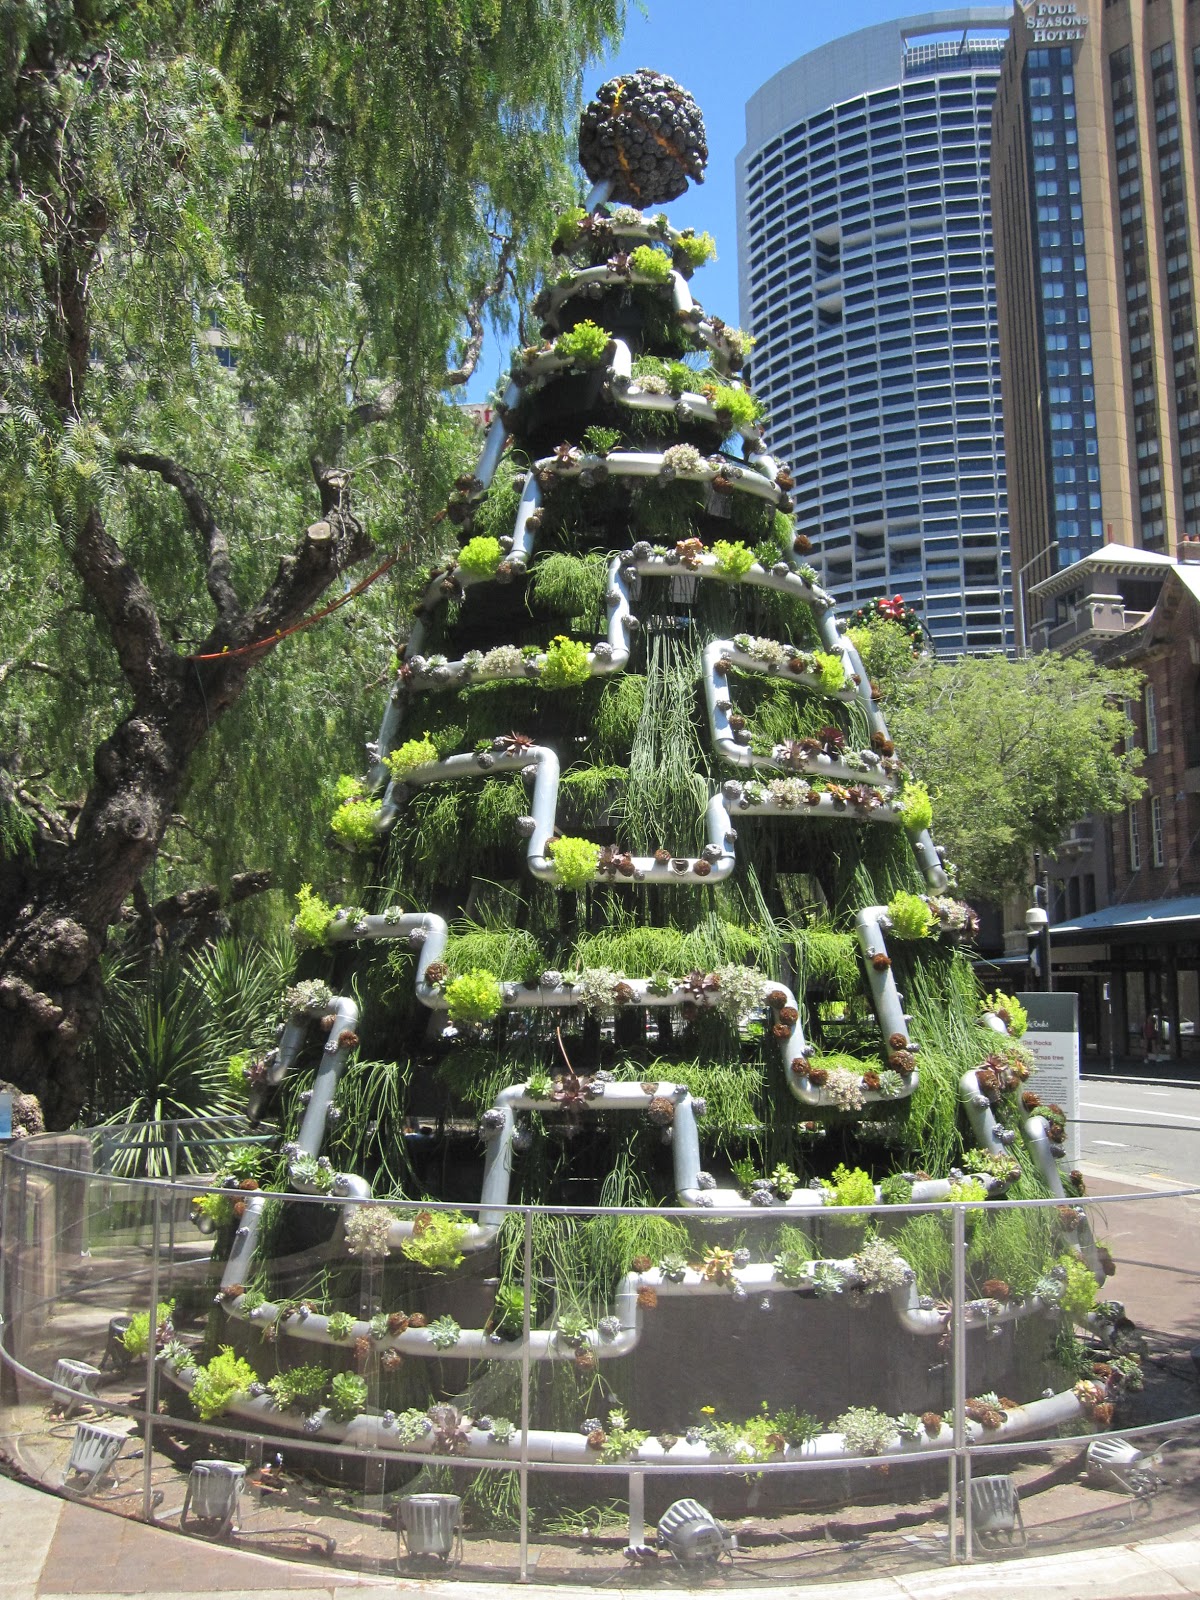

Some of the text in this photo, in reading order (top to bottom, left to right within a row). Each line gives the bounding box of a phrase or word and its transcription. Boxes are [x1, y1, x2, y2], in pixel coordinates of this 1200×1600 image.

[1038, 3, 1077, 15] FOUR
[1026, 15, 1089, 29] SEASONS
[1033, 29, 1085, 42] HOTEL
